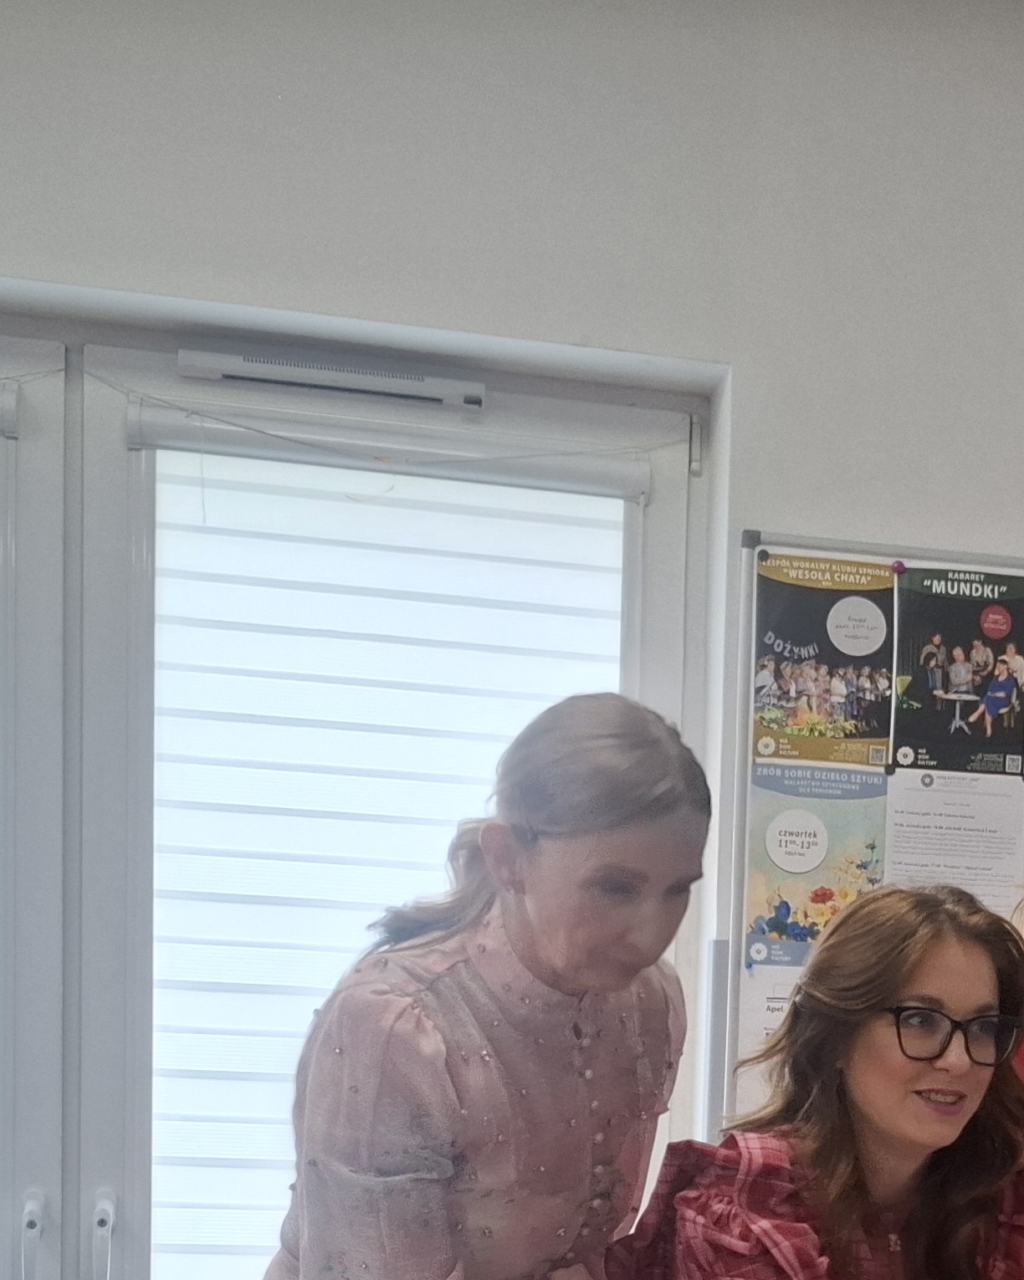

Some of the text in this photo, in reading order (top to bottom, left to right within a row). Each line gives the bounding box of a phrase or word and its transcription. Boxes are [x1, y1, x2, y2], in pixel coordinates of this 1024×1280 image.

[948, 571, 985, 582] KABARET
[763, 631, 819, 659] DOŻYNKI
[756, 767, 883, 785] ZRÓB SOBIE DZIEŁO SZTUKI
[778, 829, 818, 839] czwartek
[766, 1005, 784, 1014] Apel
